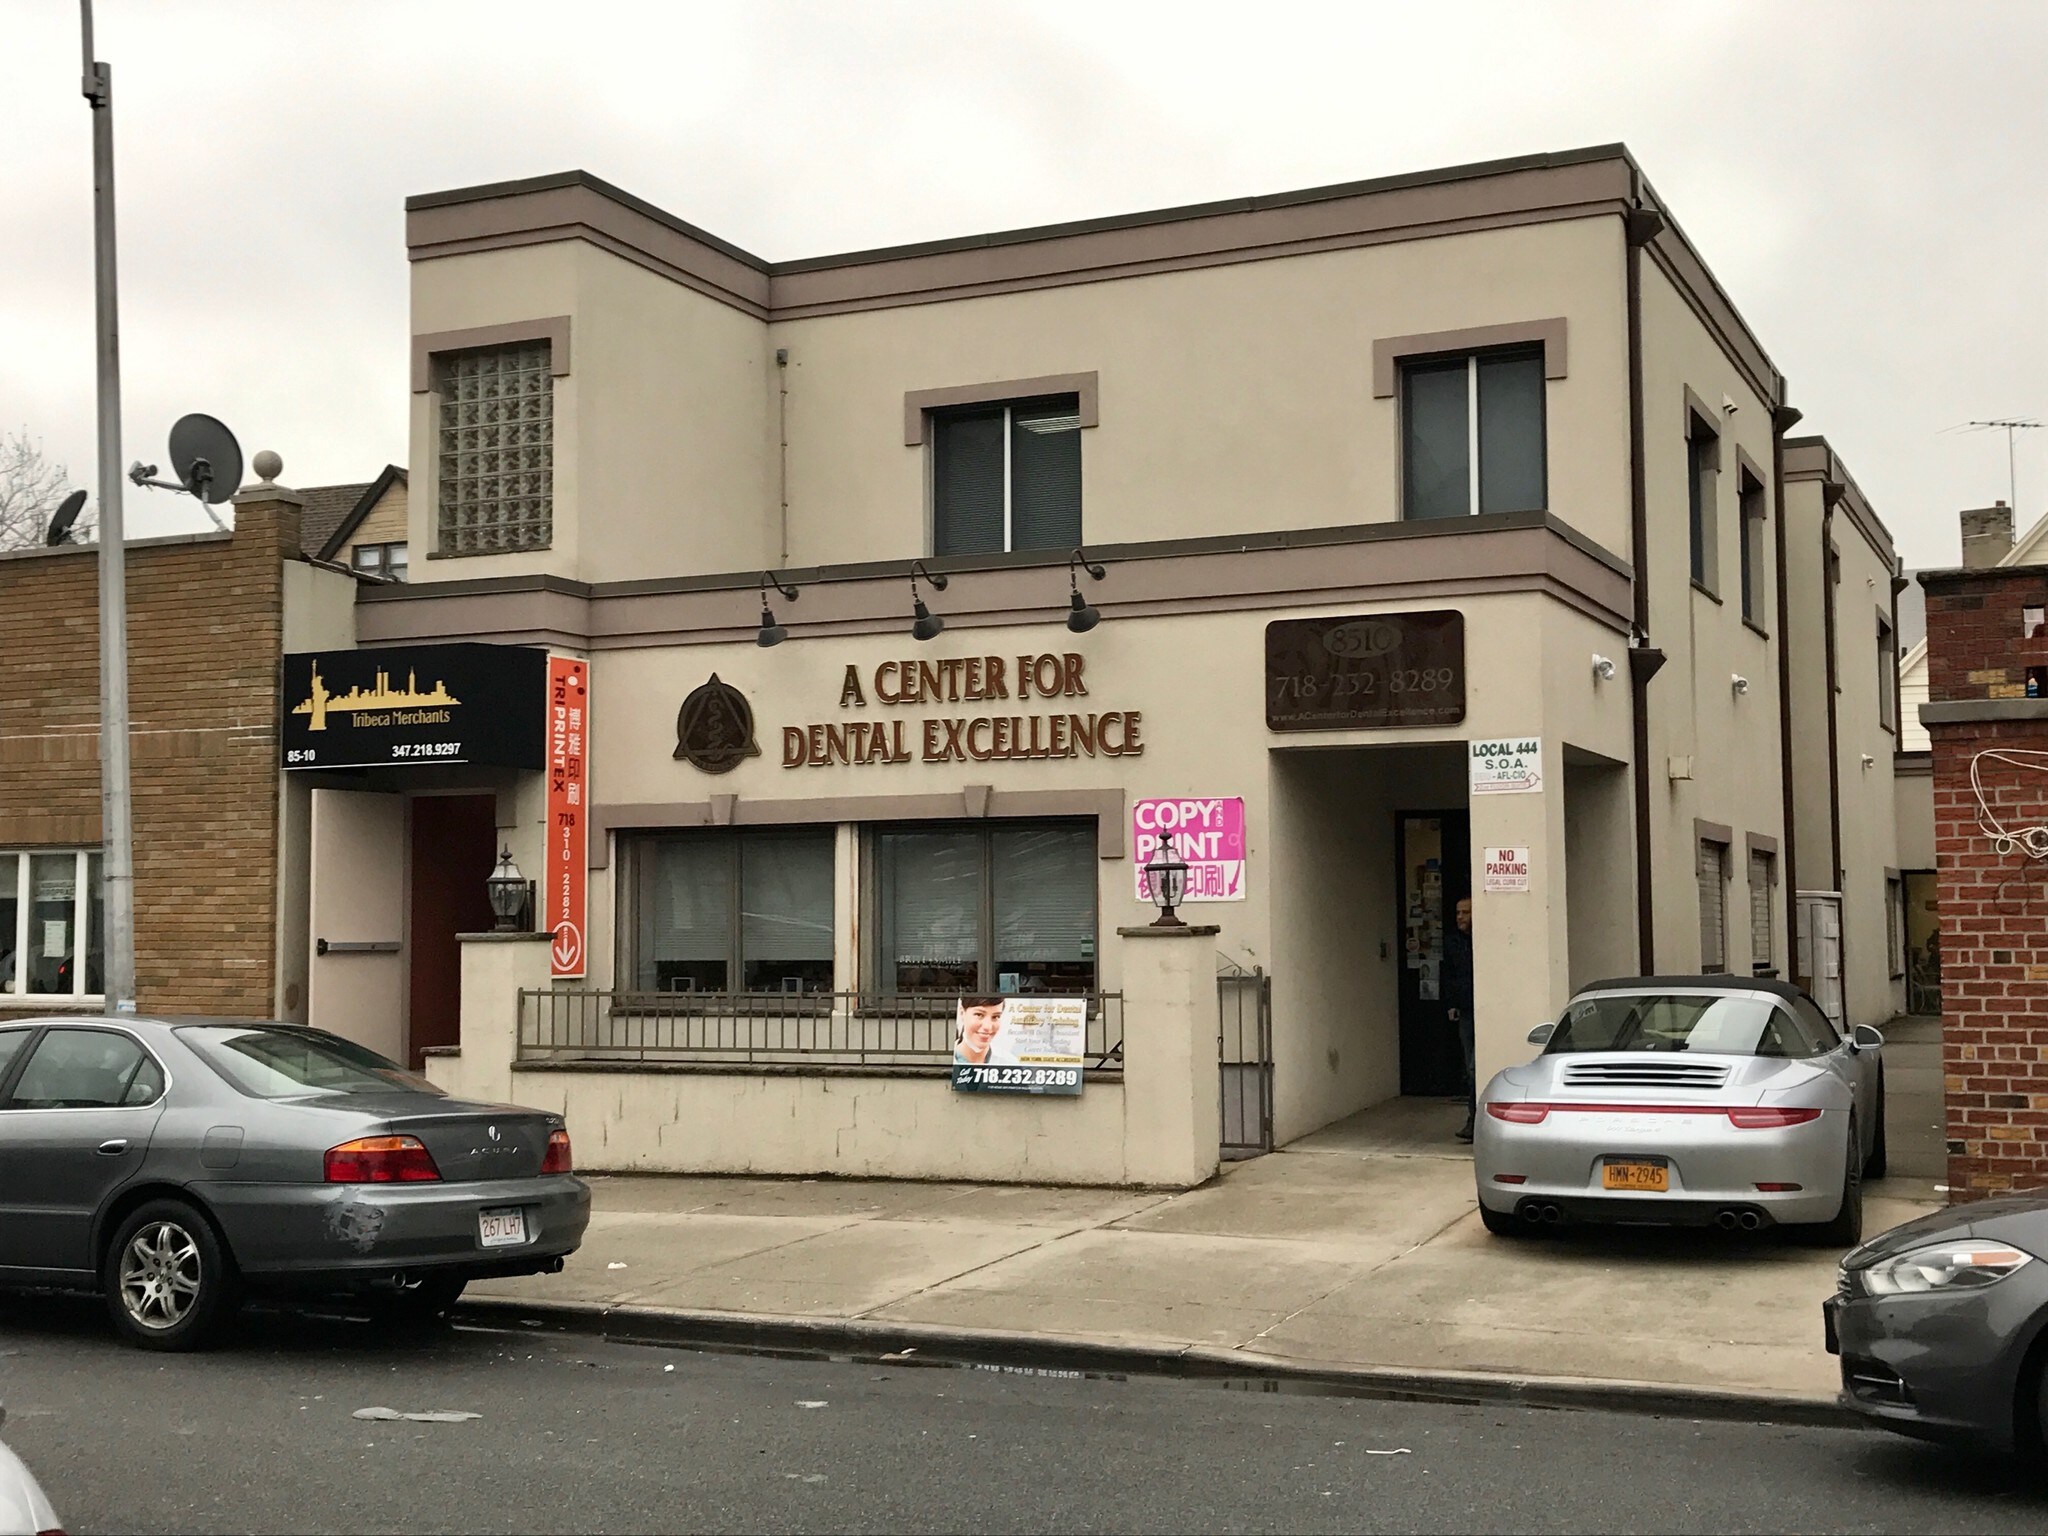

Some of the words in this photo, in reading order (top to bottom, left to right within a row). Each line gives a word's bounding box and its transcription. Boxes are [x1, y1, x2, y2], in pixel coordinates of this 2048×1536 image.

[839, 663, 866, 707] A
[874, 655, 1009, 704] CENTER
[1016, 652, 1089, 699] FOR
[1275, 667, 1454, 699] 718-232-8289
[352, 712, 390, 728] Tribeca
[393, 709, 451, 725] Merchants
[553, 675, 566, 793] TRIPRINTEX
[781, 719, 913, 768] DENTAL
[922, 710, 1146, 763] EXCELLENCE
[287, 750, 316, 762] 85-10
[392, 743, 461, 757] 347.218.9297
[1472, 743, 1514, 757] LOCAL
[1516, 742, 1537, 754] 444
[1485, 758, 1528, 770] S.O.A.
[558, 813, 575, 826] 718
[1135, 801, 1216, 830] COPY
[1215, 800, 1224, 827] AND
[1499, 850, 1514, 861] NO
[1486, 863, 1527, 875] PARKING
[973, 1068, 1078, 1086] 718.232.8289
[482, 1218, 500, 1237] 267
[503, 1217, 521, 1235] LH7
